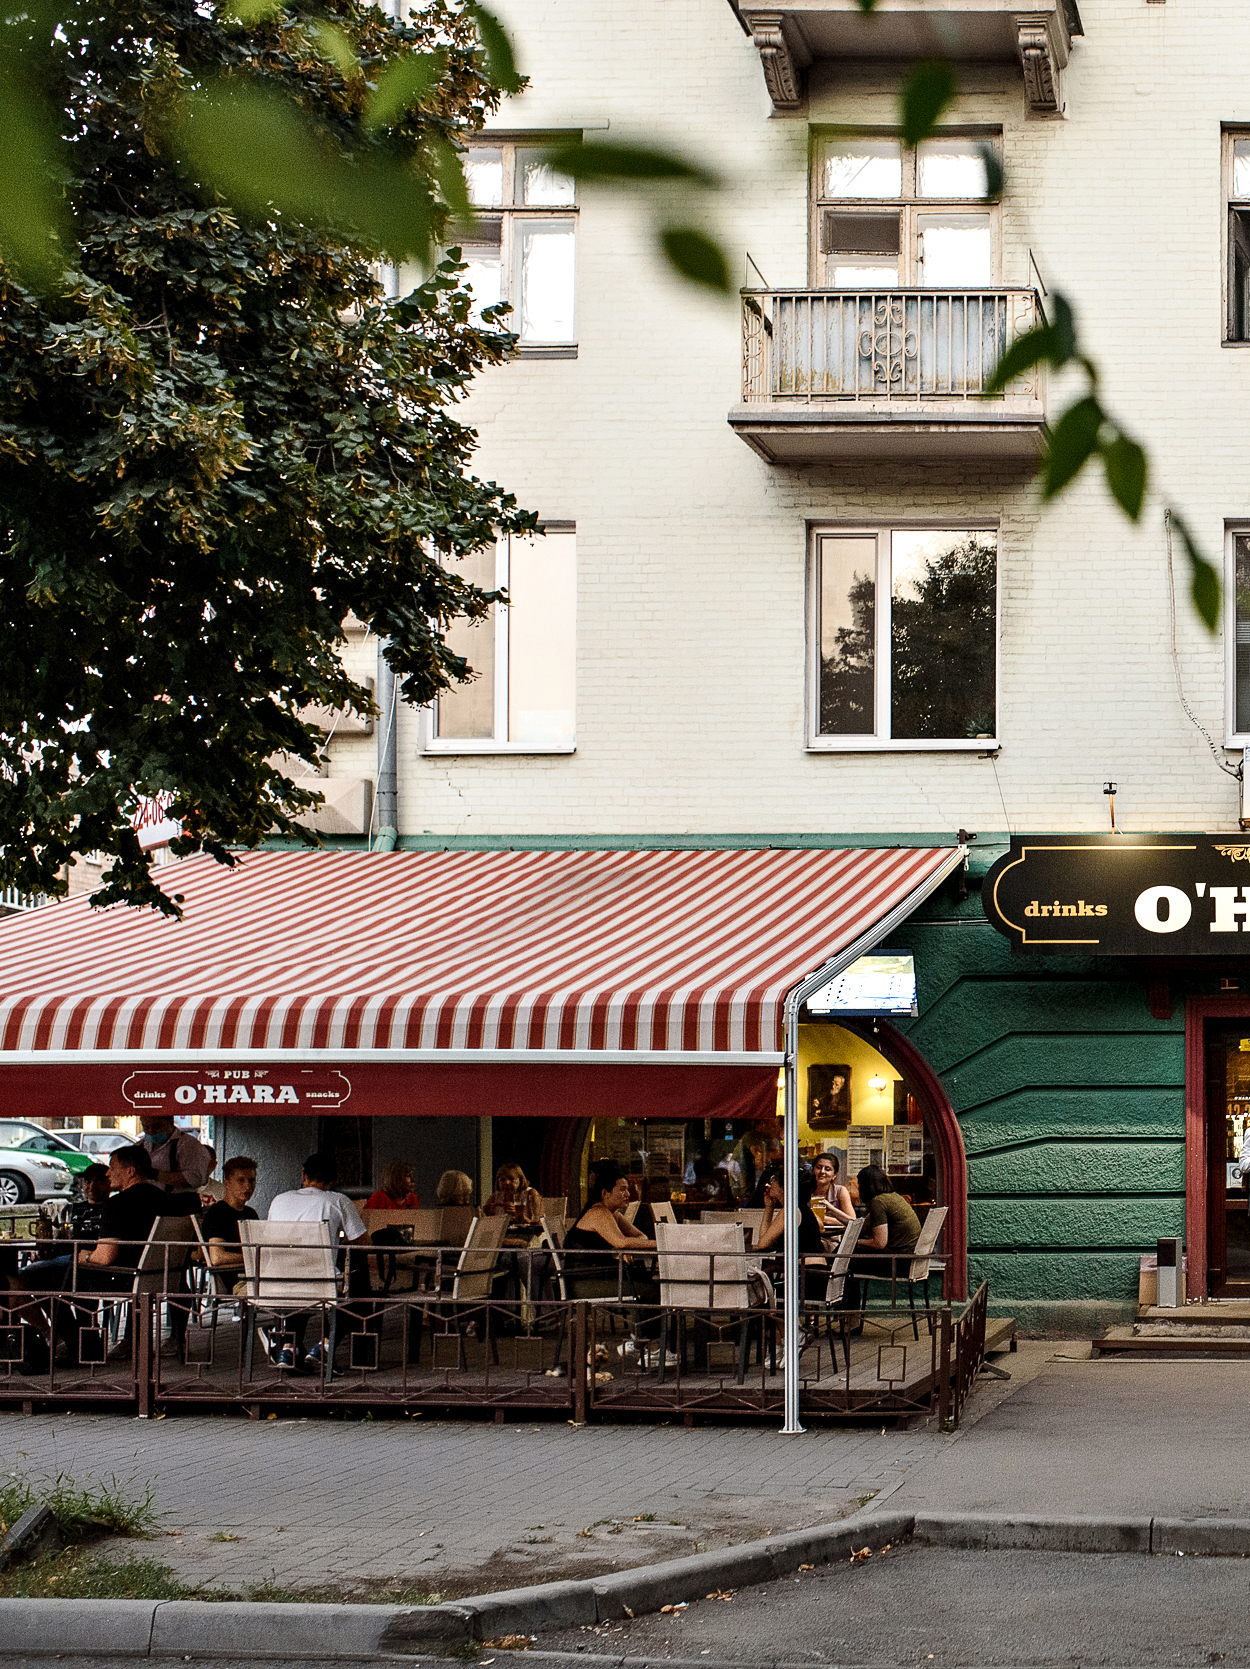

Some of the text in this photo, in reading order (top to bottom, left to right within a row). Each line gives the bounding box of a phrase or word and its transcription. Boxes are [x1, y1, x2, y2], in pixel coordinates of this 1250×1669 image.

[1024, 899, 1108, 918] drinks
[223, 1070, 250, 1079] PUB
[133, 1090, 167, 1099] drinks
[174, 1083, 300, 1105] O'HARA
[305, 1089, 340, 1098] snacks
